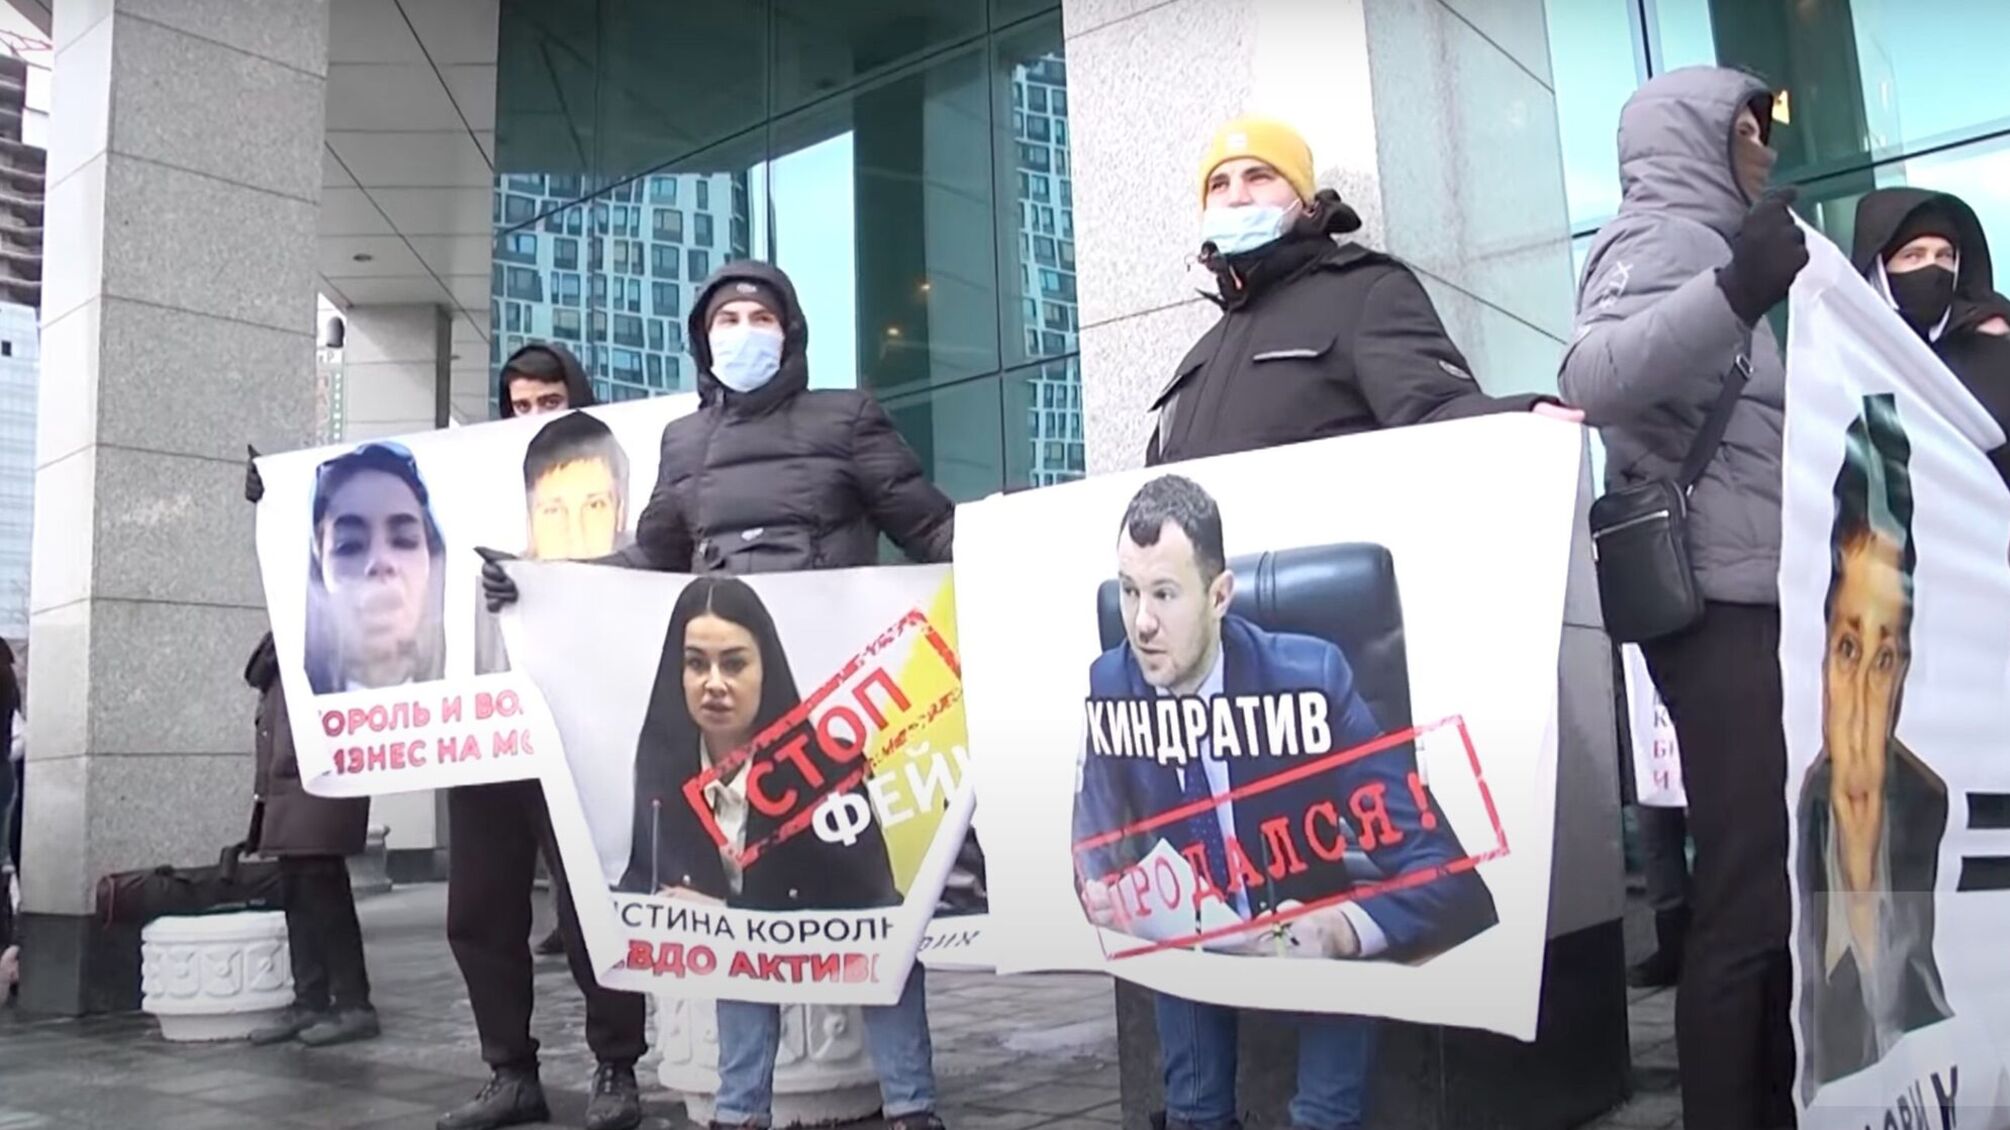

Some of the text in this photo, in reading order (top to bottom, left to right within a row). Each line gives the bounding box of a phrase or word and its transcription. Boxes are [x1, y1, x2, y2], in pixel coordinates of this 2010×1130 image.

[318, 689, 524, 738] ОРОЛЬ И ВО
[1086, 691, 1333, 766] КИНДРАТИВ
[437, 734, 482, 764] НА
[746, 667, 912, 817] СТОП
[613, 901, 735, 941] СТИНА
[612, 939, 880, 984] ВДО АКТИВ
